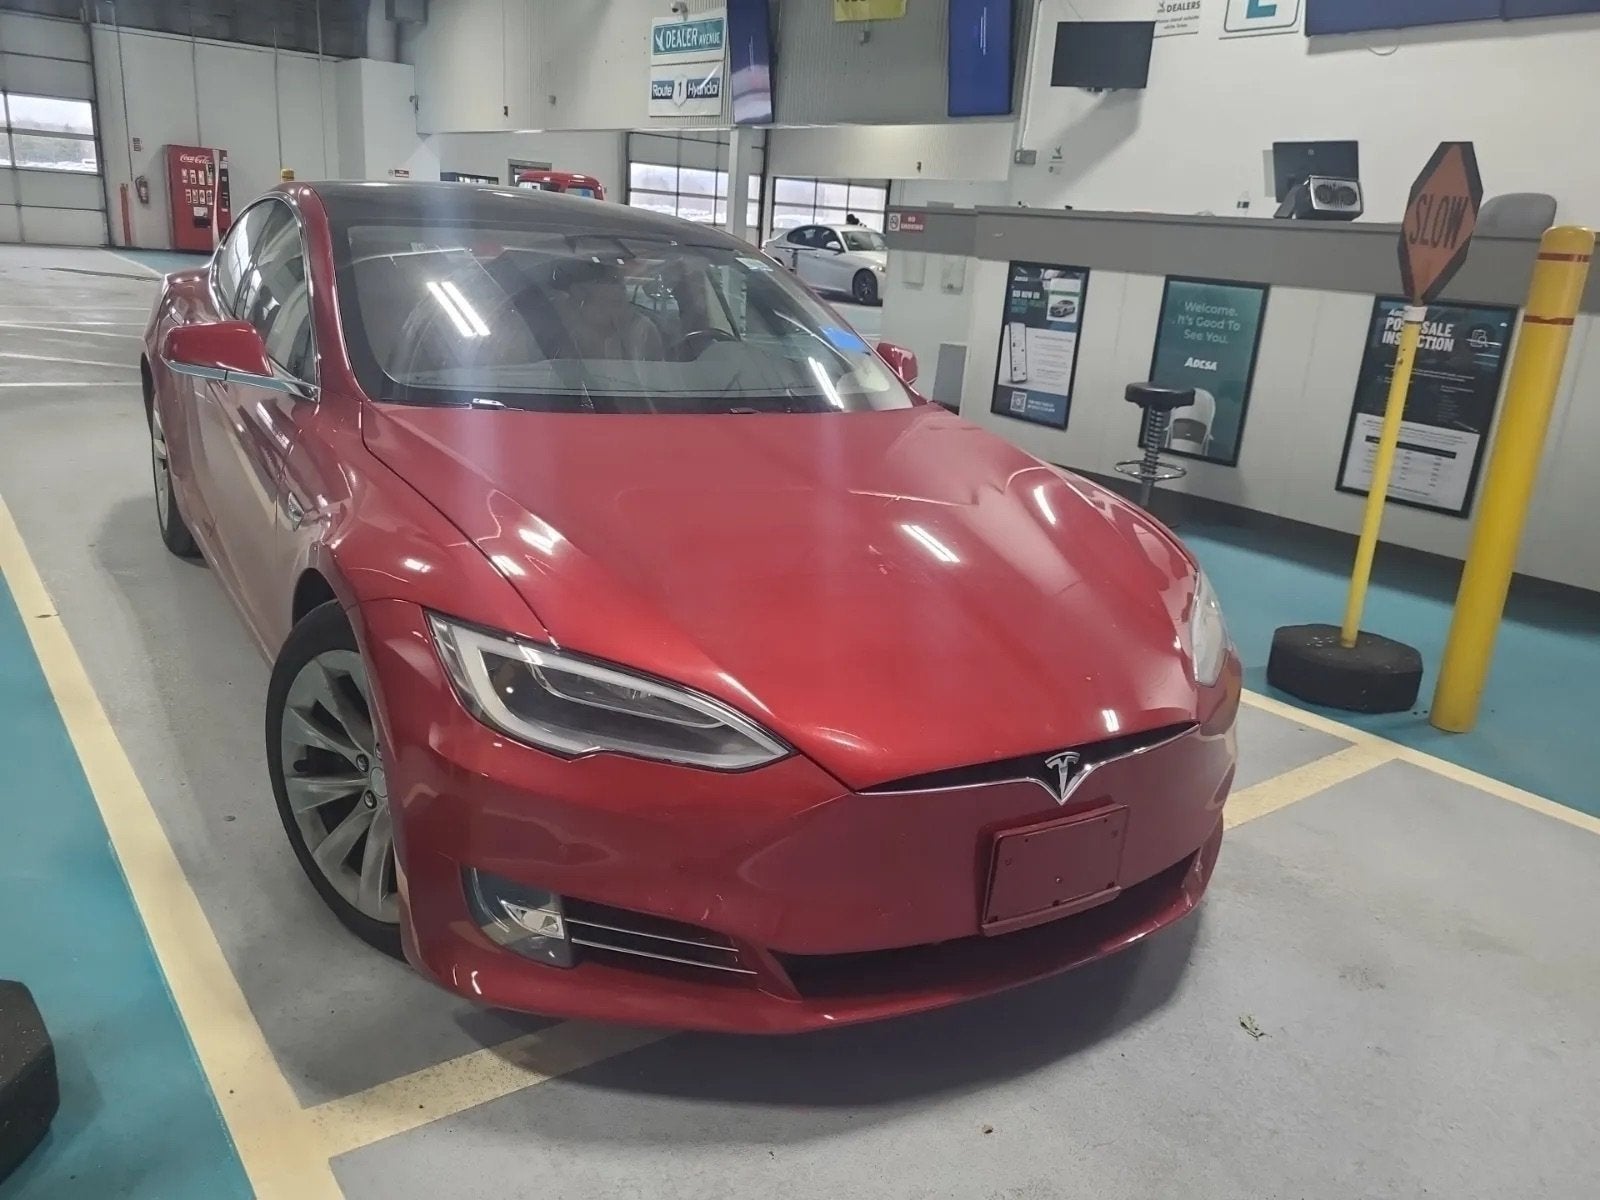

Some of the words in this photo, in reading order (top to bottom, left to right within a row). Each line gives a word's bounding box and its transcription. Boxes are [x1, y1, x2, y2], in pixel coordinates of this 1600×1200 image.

[1167, 1, 1200, 13] DEALERS
[666, 27, 697, 49] DEALER
[699, 31, 721, 46] AVENUE
[652, 84, 672, 97] Route
[678, 81, 682, 97] 1
[1409, 193, 1468, 249] SLOW
[1184, 301, 1238, 317] Welcome.
[1196, 316, 1225, 329] Good
[1228, 320, 1240, 331] To
[1184, 329, 1203, 341] See
[1382, 330, 1455, 352] INSCTION
